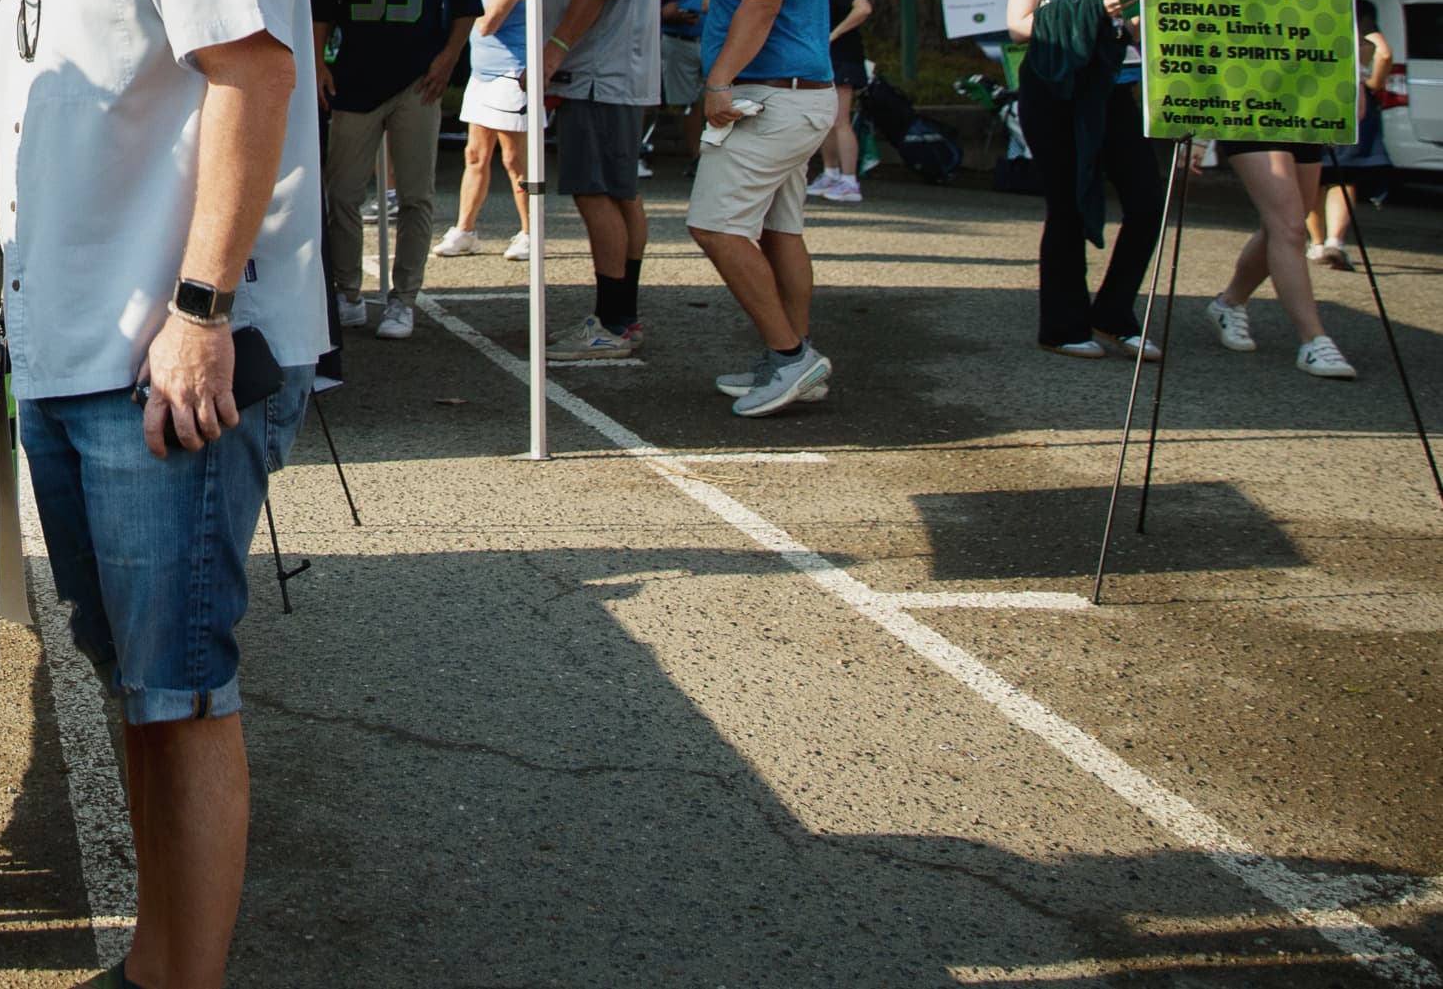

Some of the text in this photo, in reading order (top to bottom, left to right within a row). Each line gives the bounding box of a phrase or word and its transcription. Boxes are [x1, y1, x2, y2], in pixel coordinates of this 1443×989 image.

[1158, 2, 1241, 17] GRENADE
[1158, 18, 1311, 40] $20 ea, Limit 1 pp
[1160, 43, 1338, 62] WINE & SPIRITS PULL
[1160, 60, 1217, 75] $20 ea
[1162, 95, 1287, 112] Accepting Cash,
[1162, 111, 1346, 130] Venmo, and Credit Card
